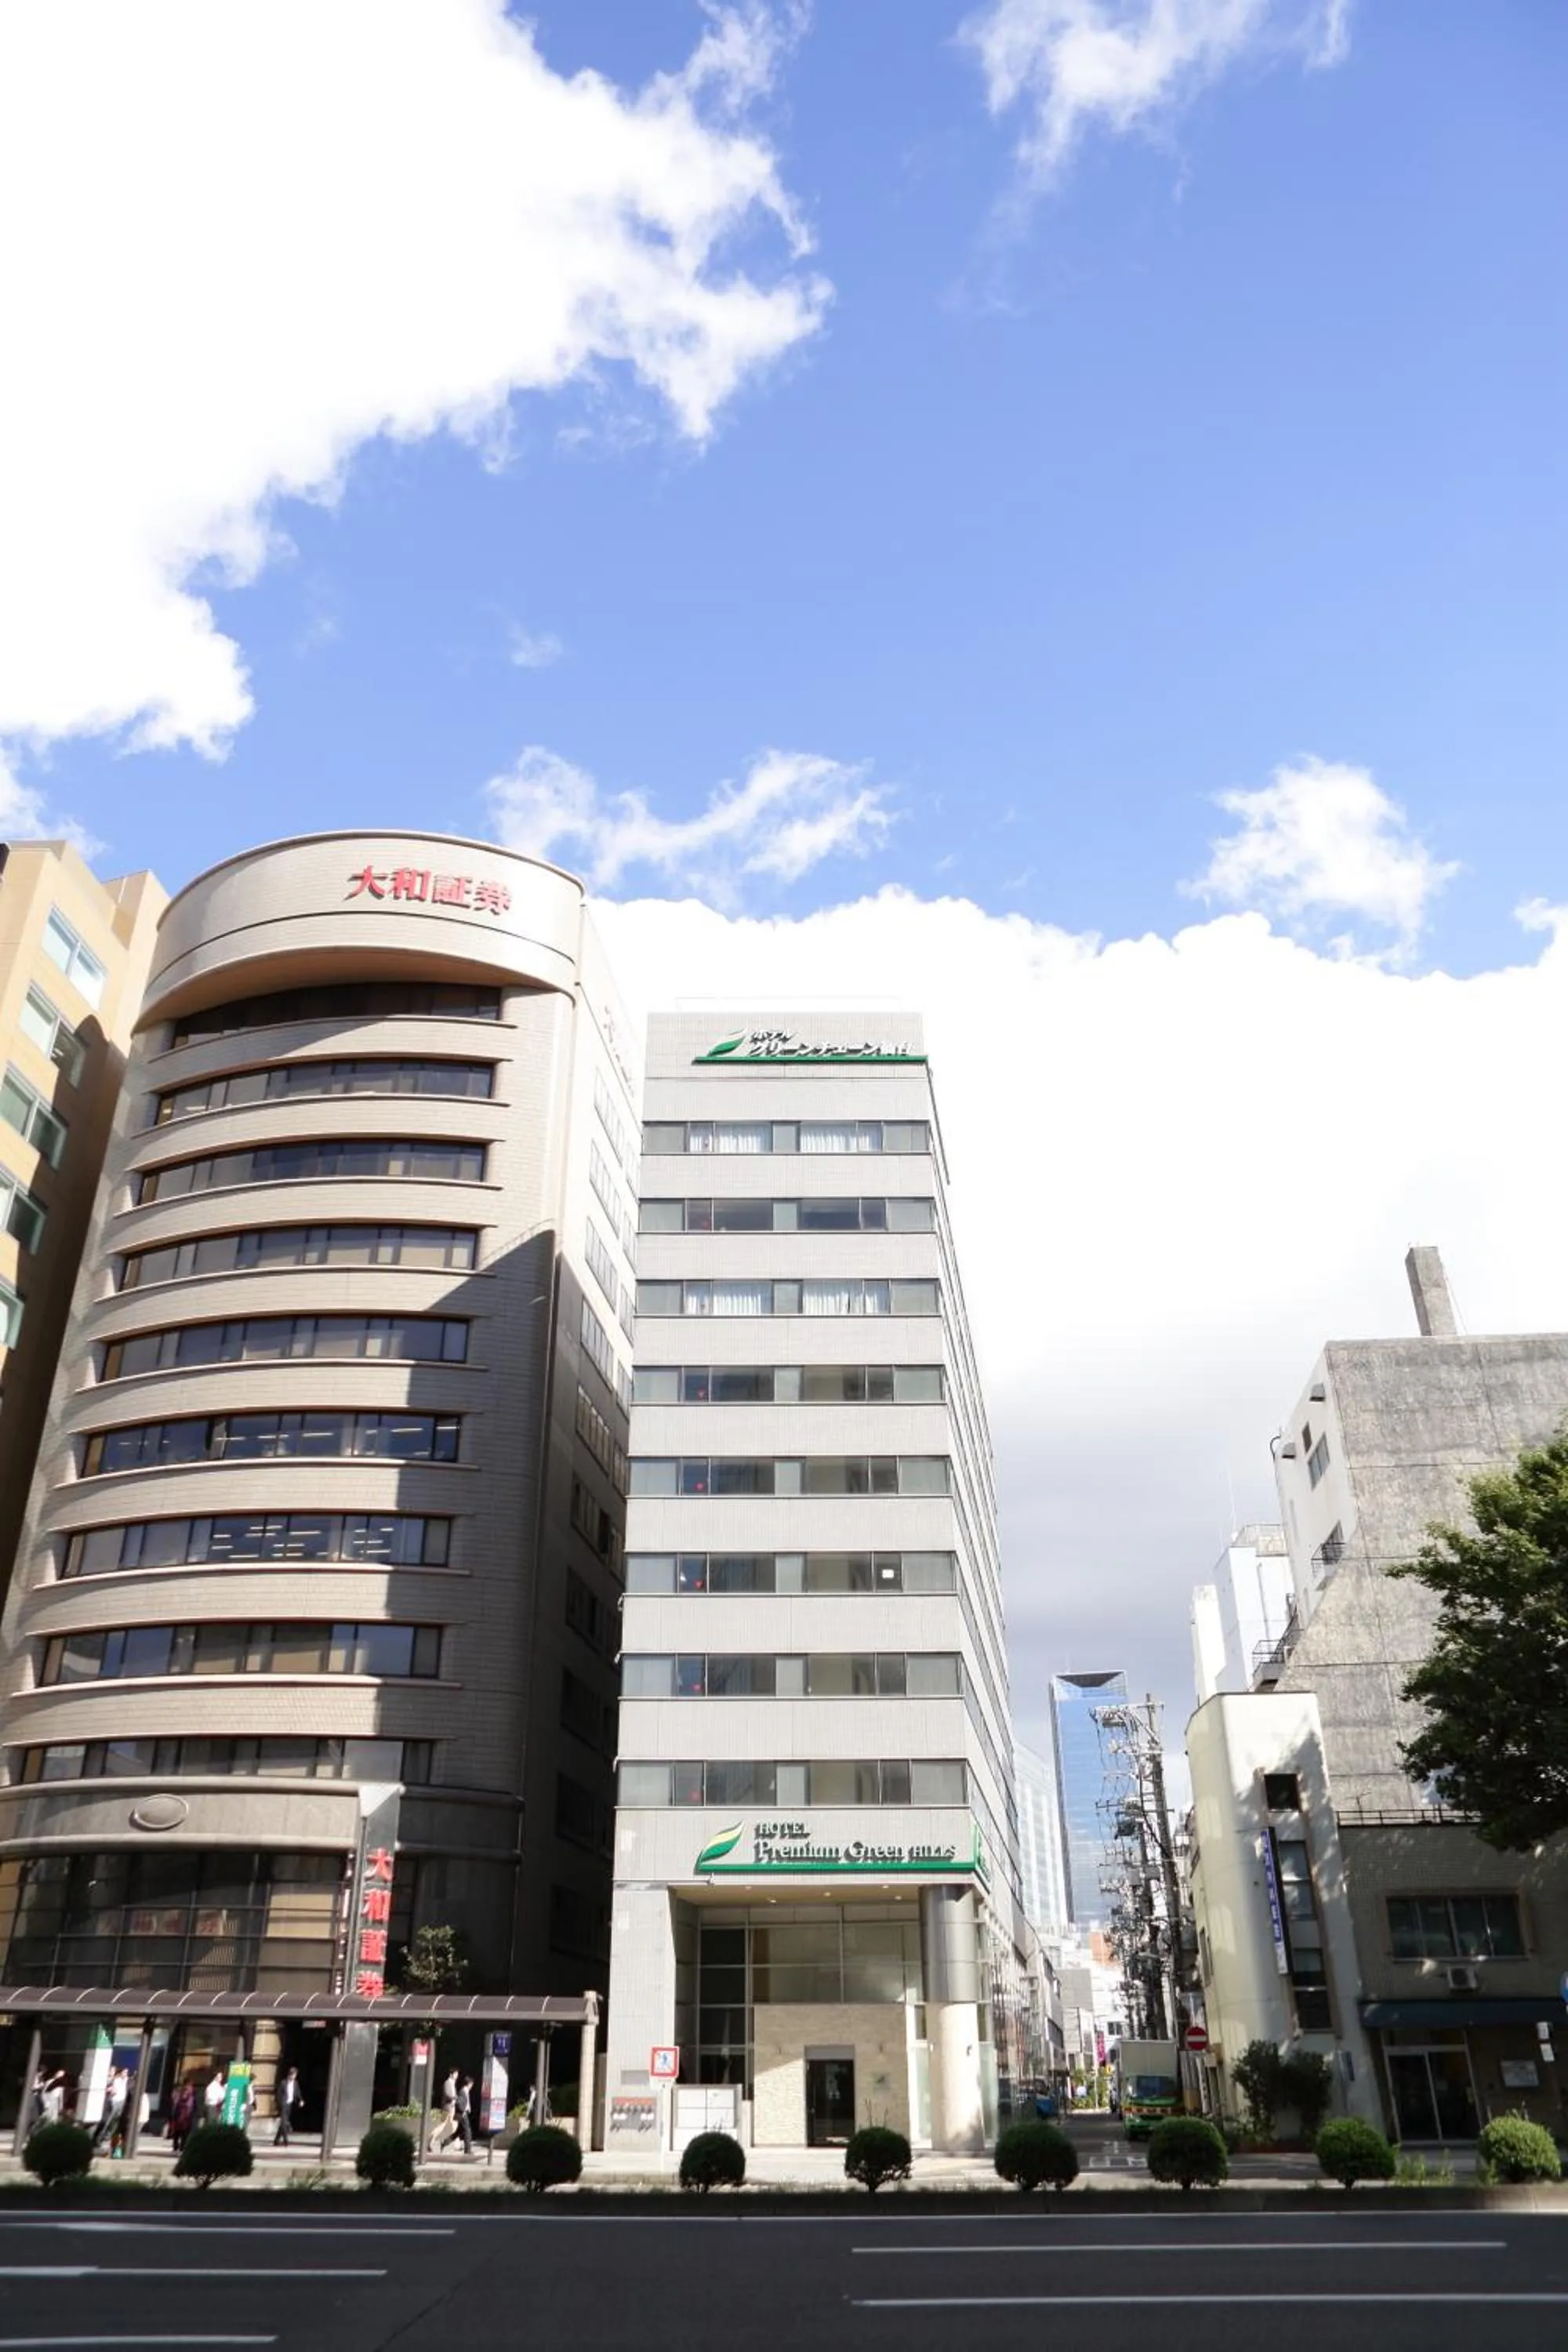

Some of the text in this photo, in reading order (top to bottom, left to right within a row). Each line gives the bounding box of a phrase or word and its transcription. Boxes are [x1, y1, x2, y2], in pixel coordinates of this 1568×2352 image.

[343, 865, 512, 915] 大和証券
[751, 1029, 792, 1042] ホテル
[755, 1822, 810, 1838] HOTEL
[755, 1841, 956, 1860] Premium Green HILLS
[355, 1847, 394, 1998] 大和証券
